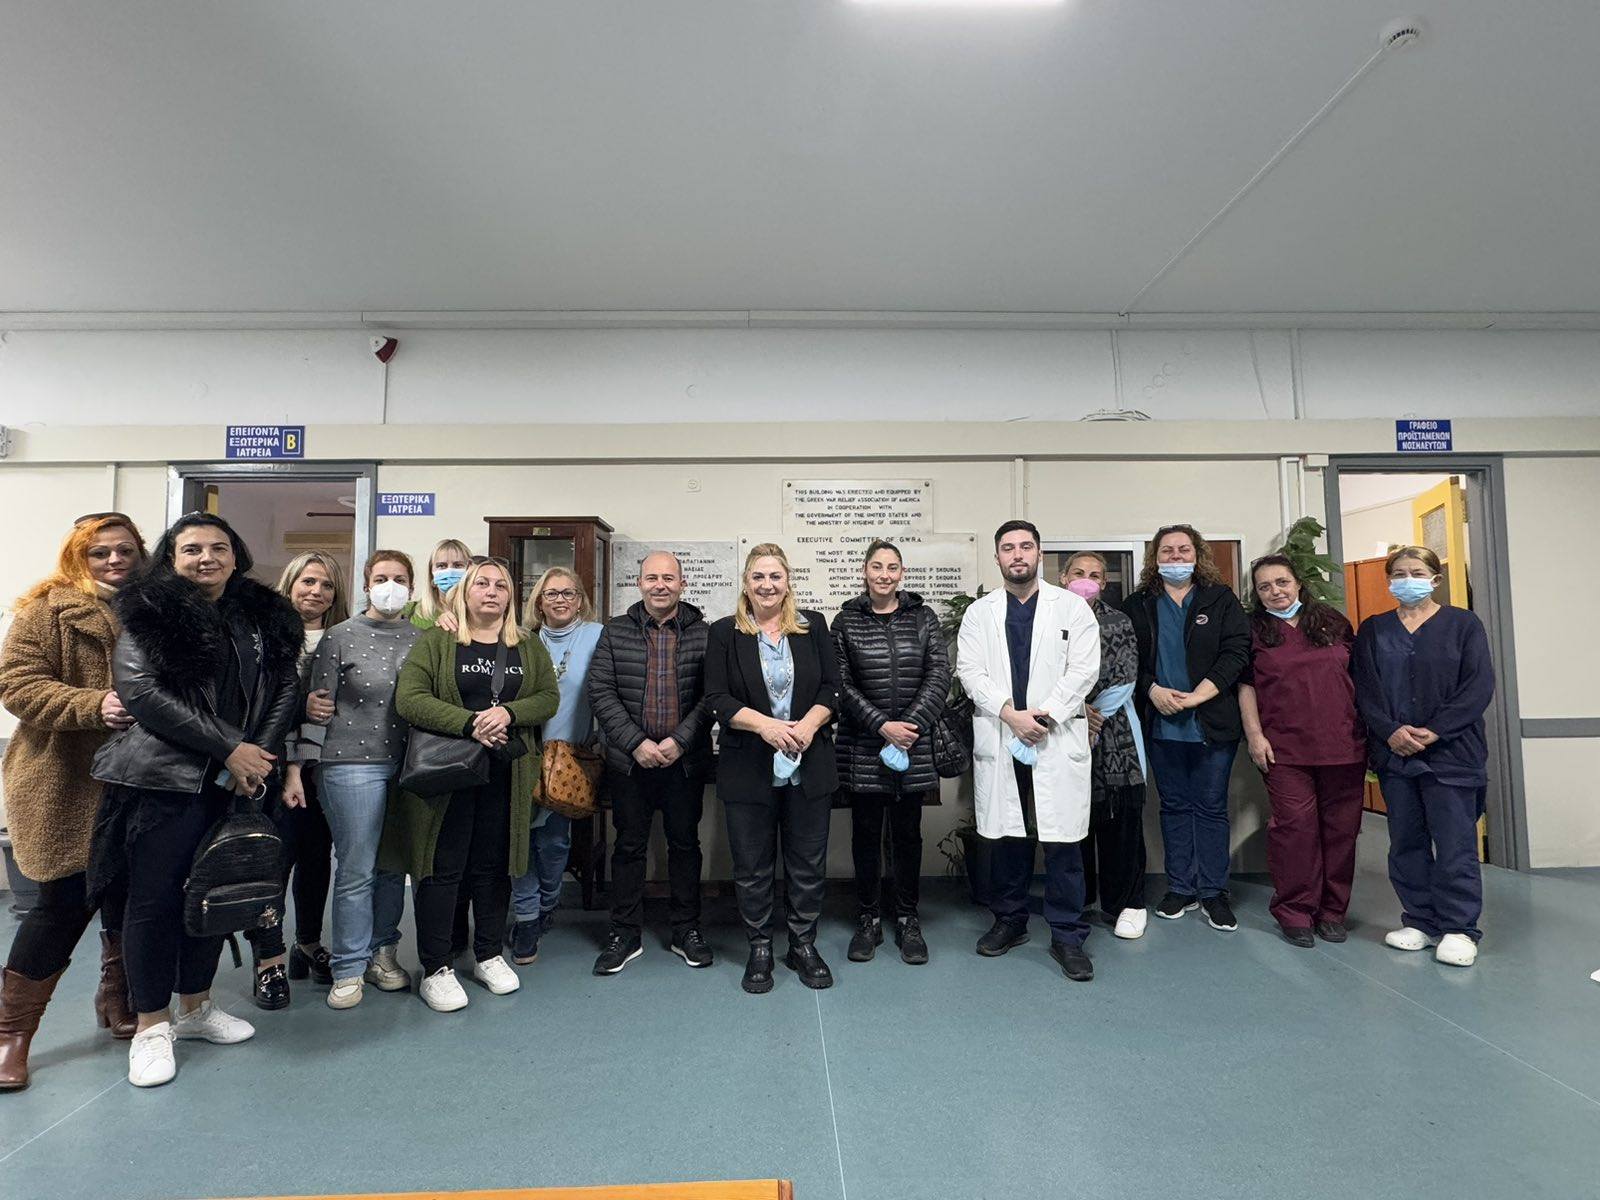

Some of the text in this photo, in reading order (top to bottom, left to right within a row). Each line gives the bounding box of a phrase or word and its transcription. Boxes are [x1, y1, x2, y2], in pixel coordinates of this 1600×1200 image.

[1409, 421, 1438, 430] ΓΡΑΦΕΙΟ
[229, 427, 280, 436] ΕΠΕΙΓΟΝΤΑ
[229, 437, 280, 447] ΕΞΩΤΕΡΙΚΑ
[1402, 441, 1447, 450] ΝΟΣΗΛΕΥΤΩΝ
[236, 448, 272, 457] ΙΑΤΡΕΙΑ
[381, 494, 430, 504] ΕΞΩΤΕΡΙΚΑ
[388, 504, 423, 514] ΙΑΤΡΕΙΑ
